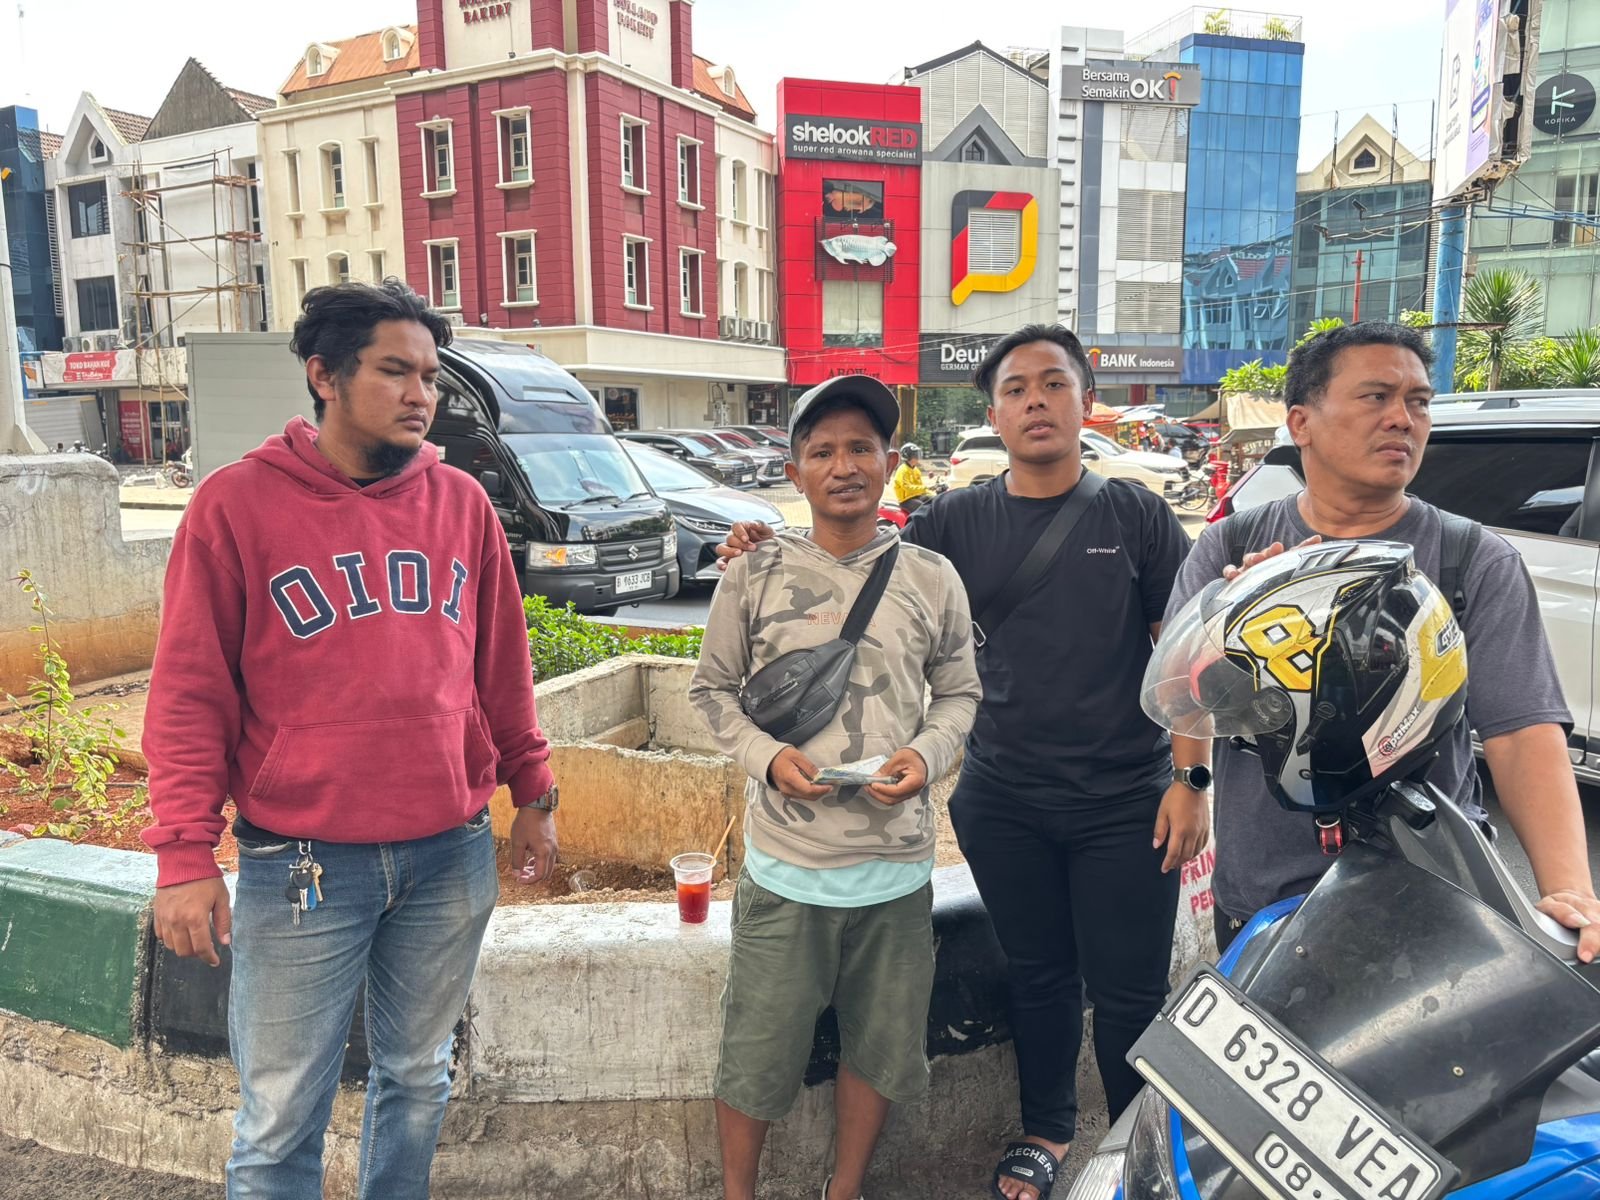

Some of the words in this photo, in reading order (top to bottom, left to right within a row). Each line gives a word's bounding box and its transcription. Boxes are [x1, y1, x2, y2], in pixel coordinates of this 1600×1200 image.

[463, 2, 512, 24] BAKERY
[1082, 69, 1129, 82] Bersama
[1082, 85, 1130, 99] Semakin
[792, 121, 918, 149] shelookRED
[793, 144, 817, 153] super
[820, 145, 835, 154] red
[837, 147, 874, 157] arowana
[876, 149, 917, 159] specialist
[940, 343, 988, 364] Deut
[1100, 353, 1138, 368] BANK
[1139, 358, 1175, 368] Indonesia
[940, 363, 970, 371] GERMAN
[1183, 986, 1218, 1027] D
[1223, 1024, 1323, 1122] 6328
[1335, 1115, 1421, 1200] VEA
